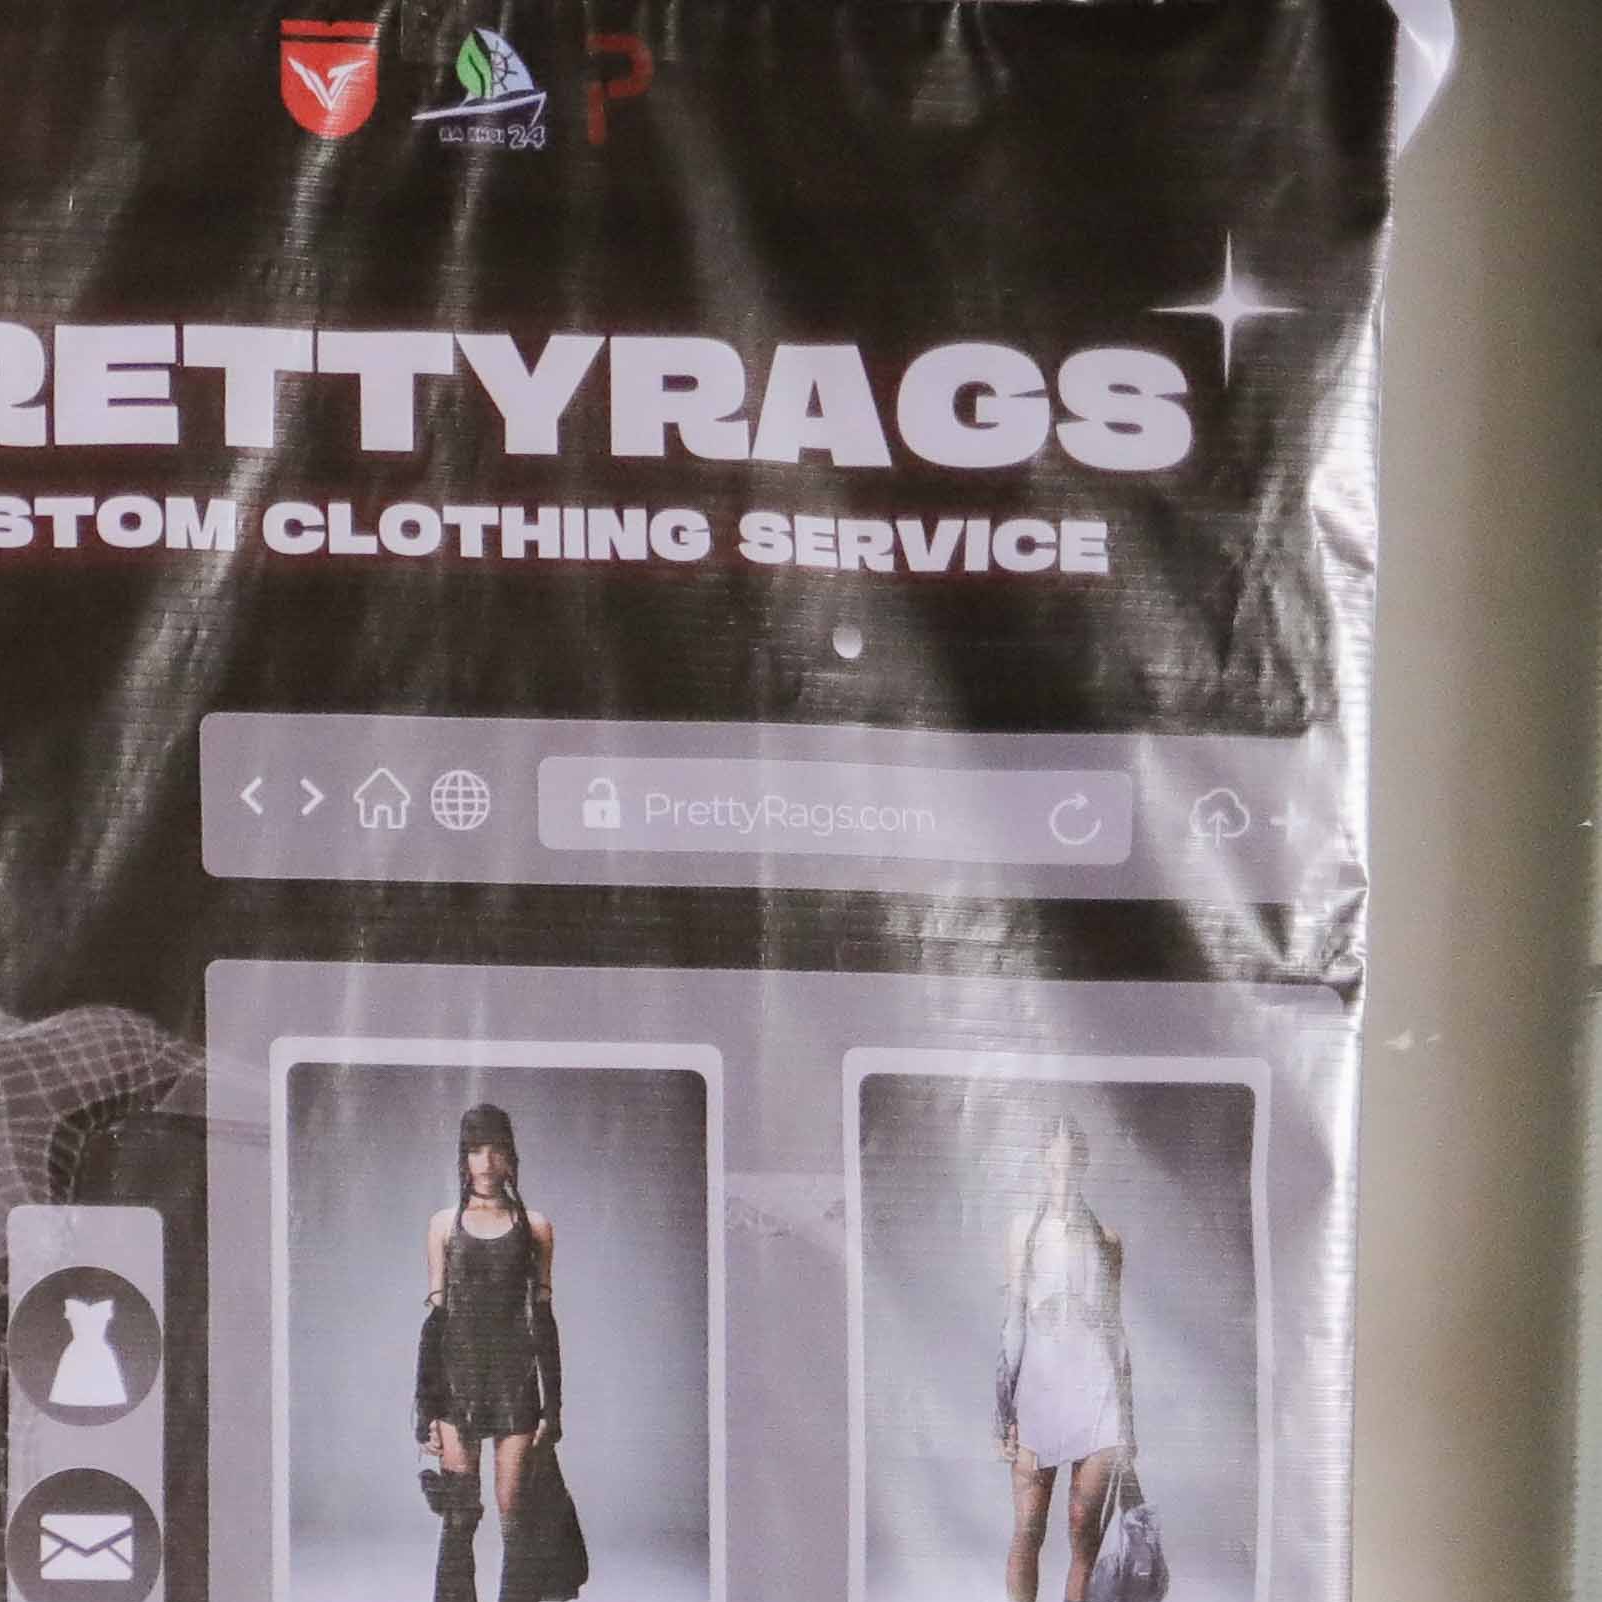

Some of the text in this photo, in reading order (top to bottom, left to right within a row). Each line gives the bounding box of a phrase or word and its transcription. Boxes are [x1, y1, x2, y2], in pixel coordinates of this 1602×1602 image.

[508, 124, 547, 150] 24
[262, 501, 711, 562] CLOTHING
[737, 511, 1109, 573] SERVICE
[642, 791, 937, 837] PrettyRags.com
